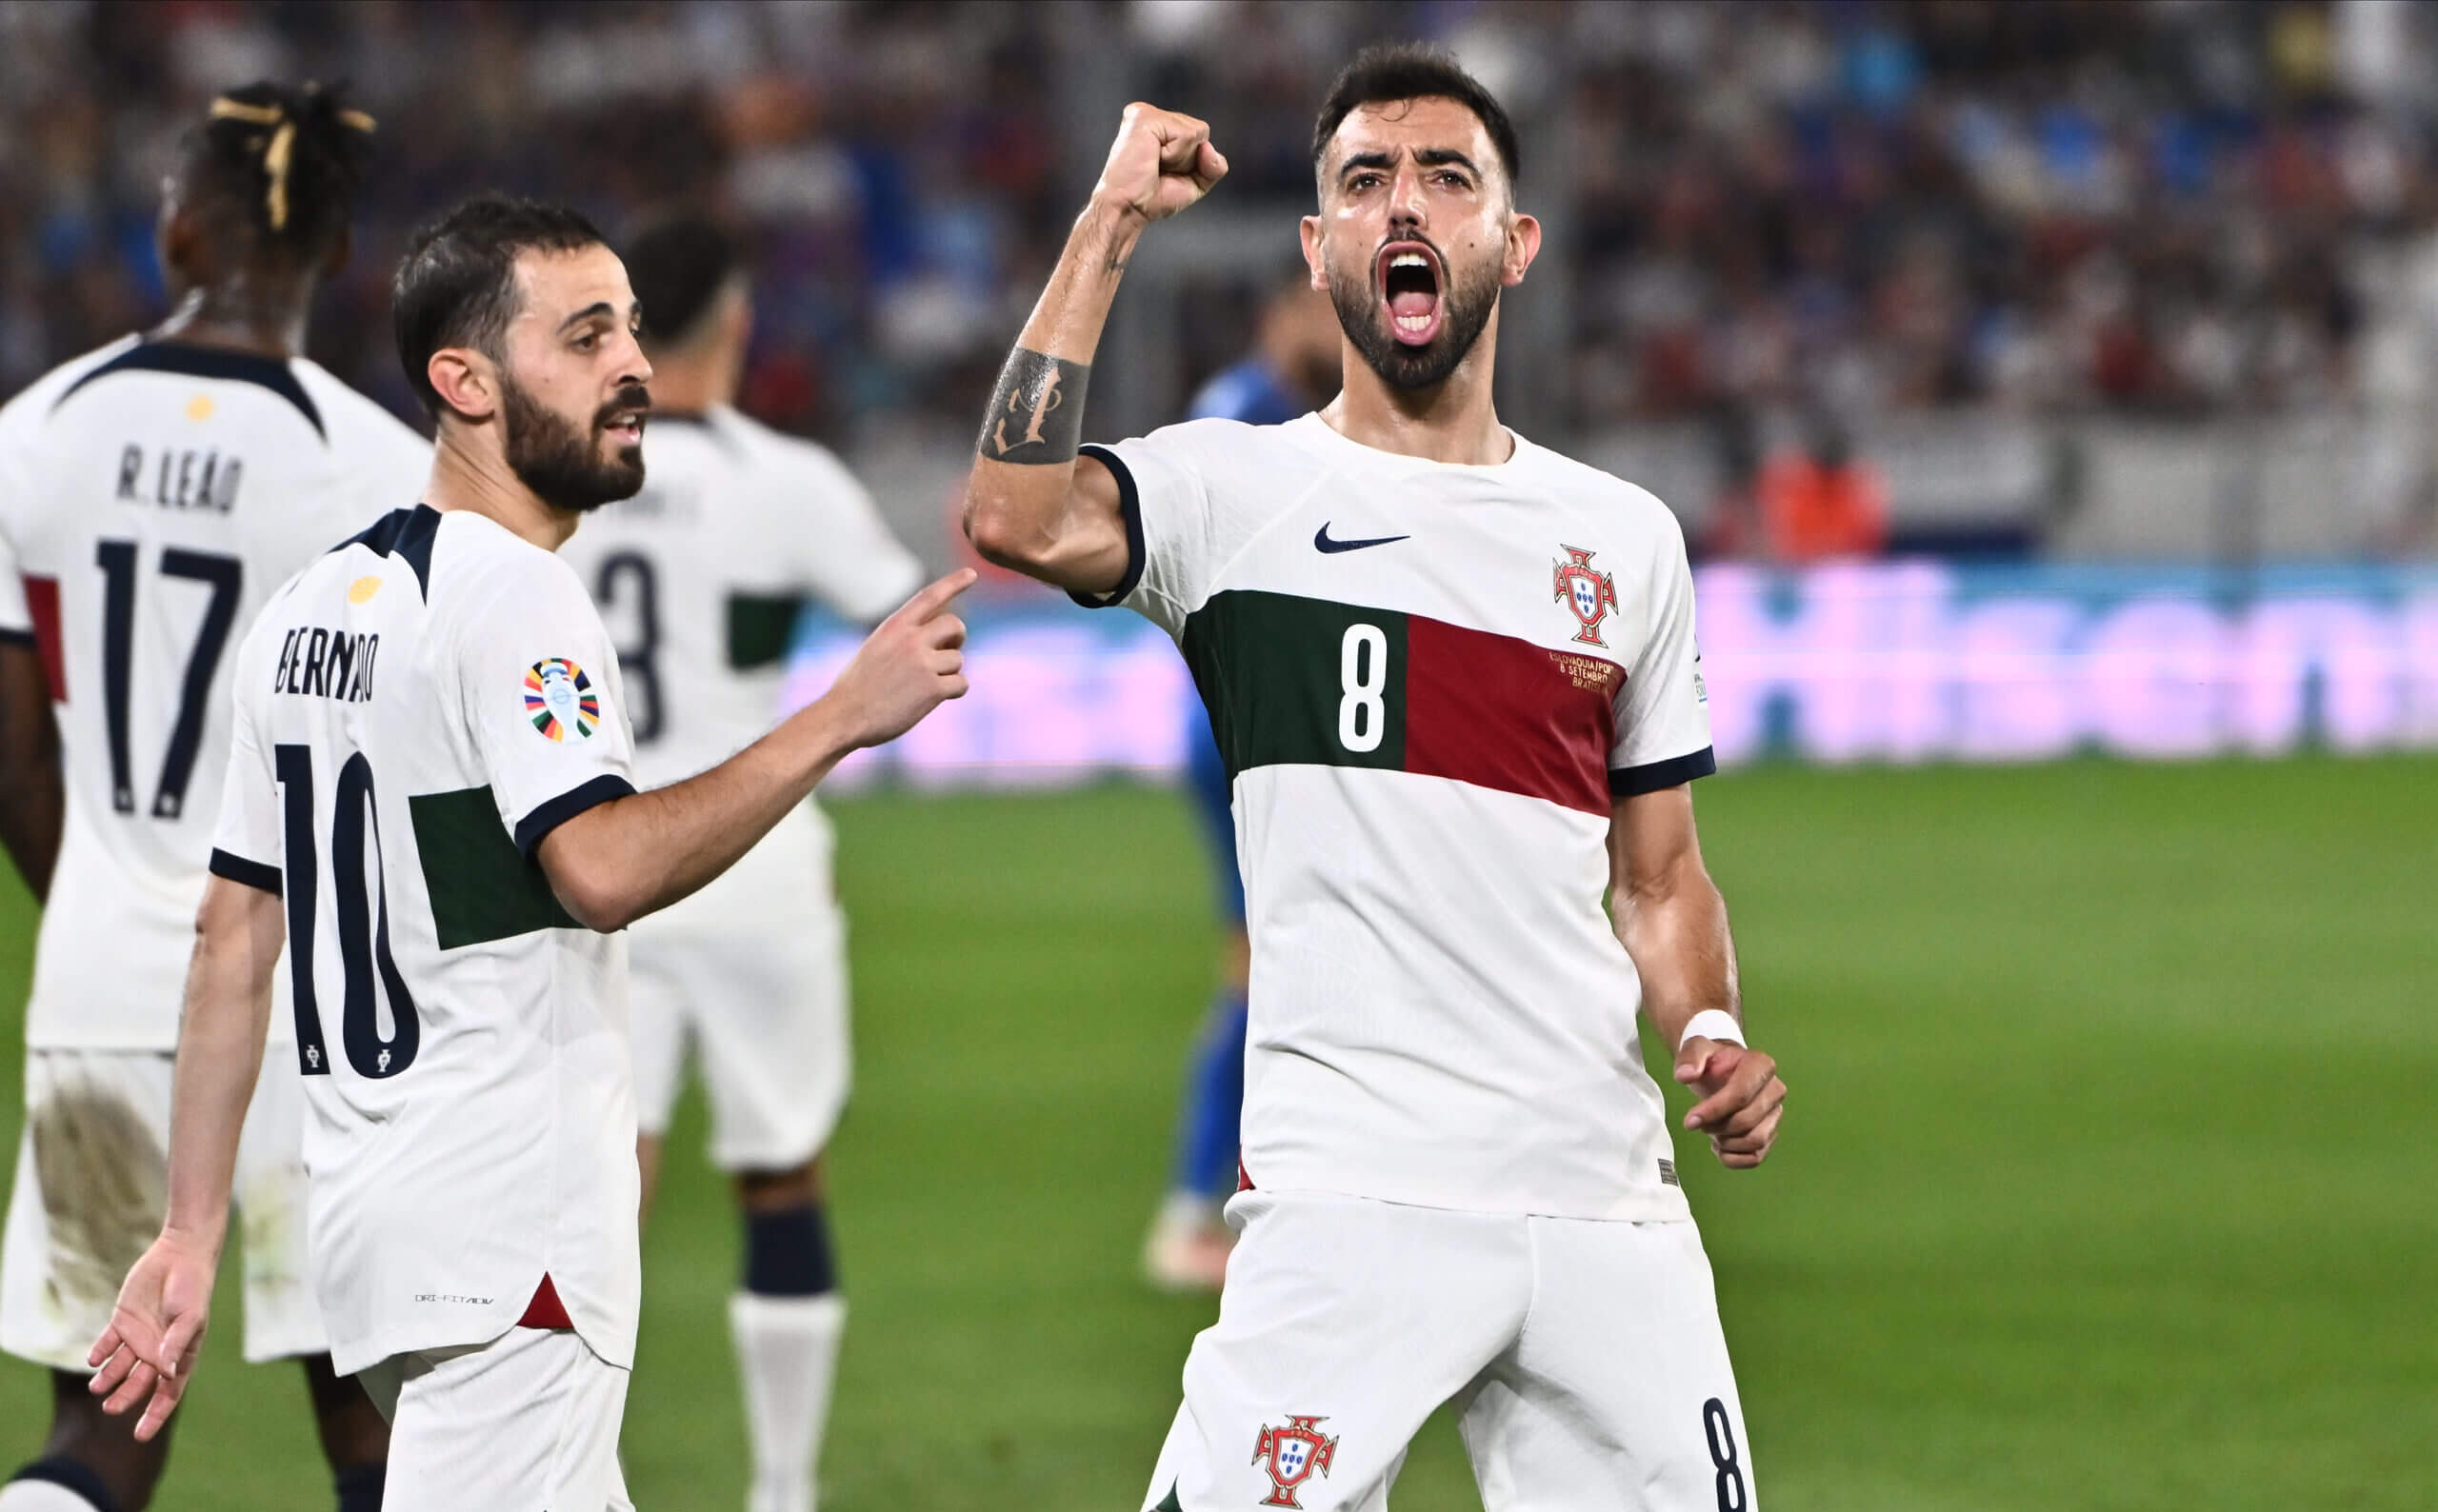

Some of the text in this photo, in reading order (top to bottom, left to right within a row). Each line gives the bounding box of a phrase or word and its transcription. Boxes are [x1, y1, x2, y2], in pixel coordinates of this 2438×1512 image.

[96, 538, 243, 819] 17
[1339, 624, 1388, 752] 8
[274, 744, 420, 1079] 10
[1703, 1397, 1747, 1512] 8
